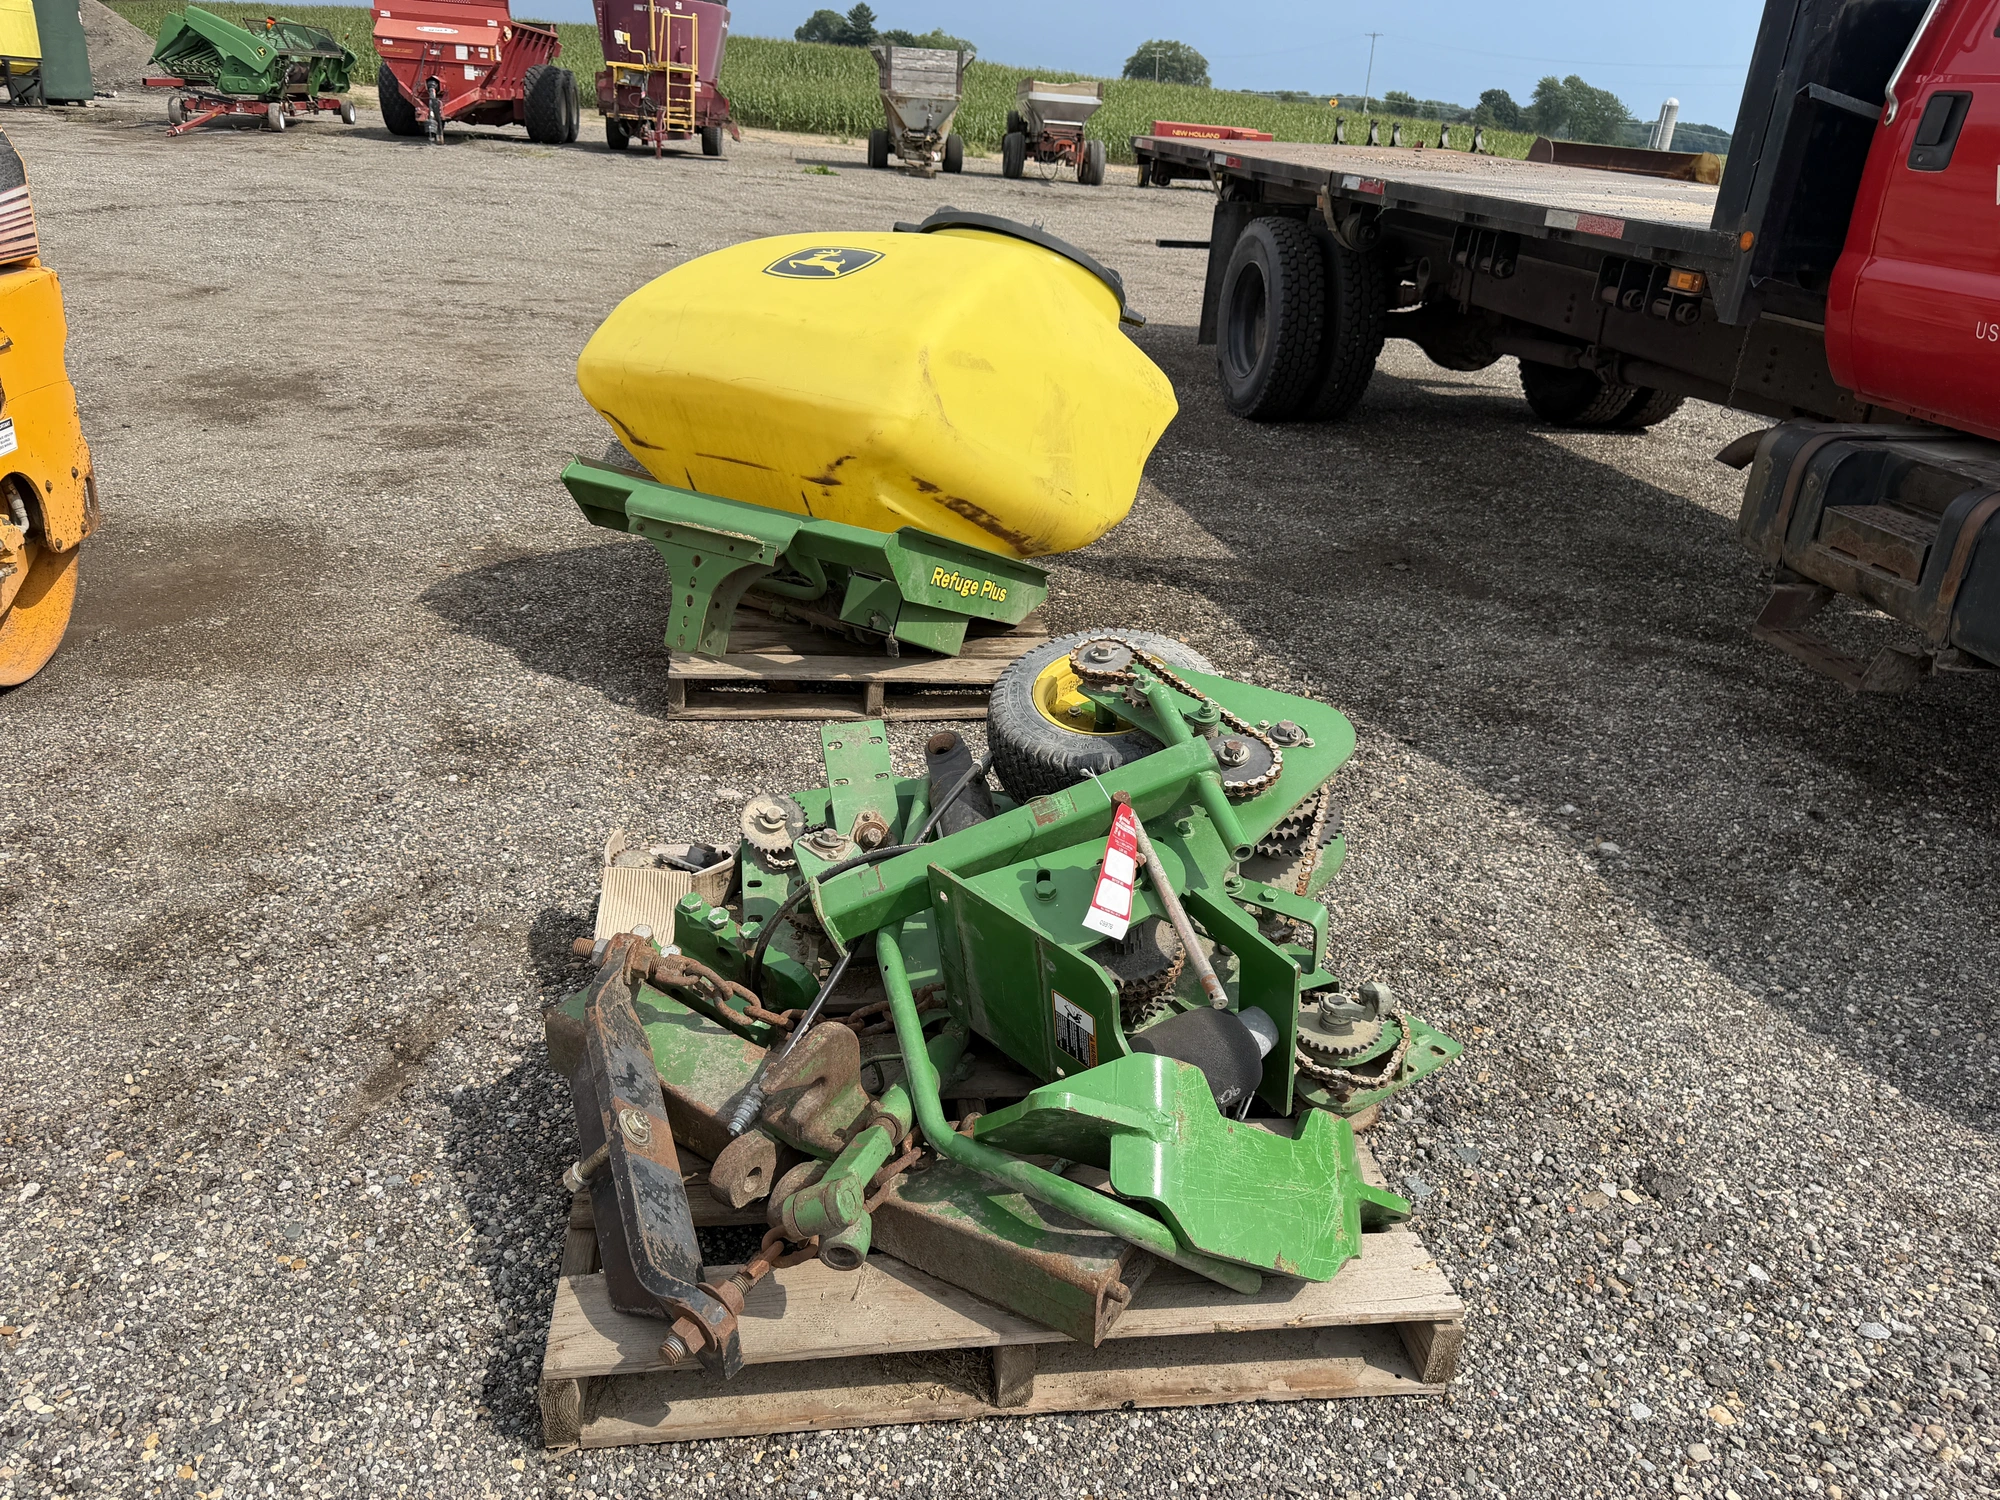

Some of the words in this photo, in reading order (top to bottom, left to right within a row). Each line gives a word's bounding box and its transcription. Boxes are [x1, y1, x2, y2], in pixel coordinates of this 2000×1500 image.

[1188, 131, 1220, 139] HOLLAND
[1975, 320, 2000, 342] US
[929, 565, 979, 598] Refuge
[979, 579, 1008, 603] Plus
